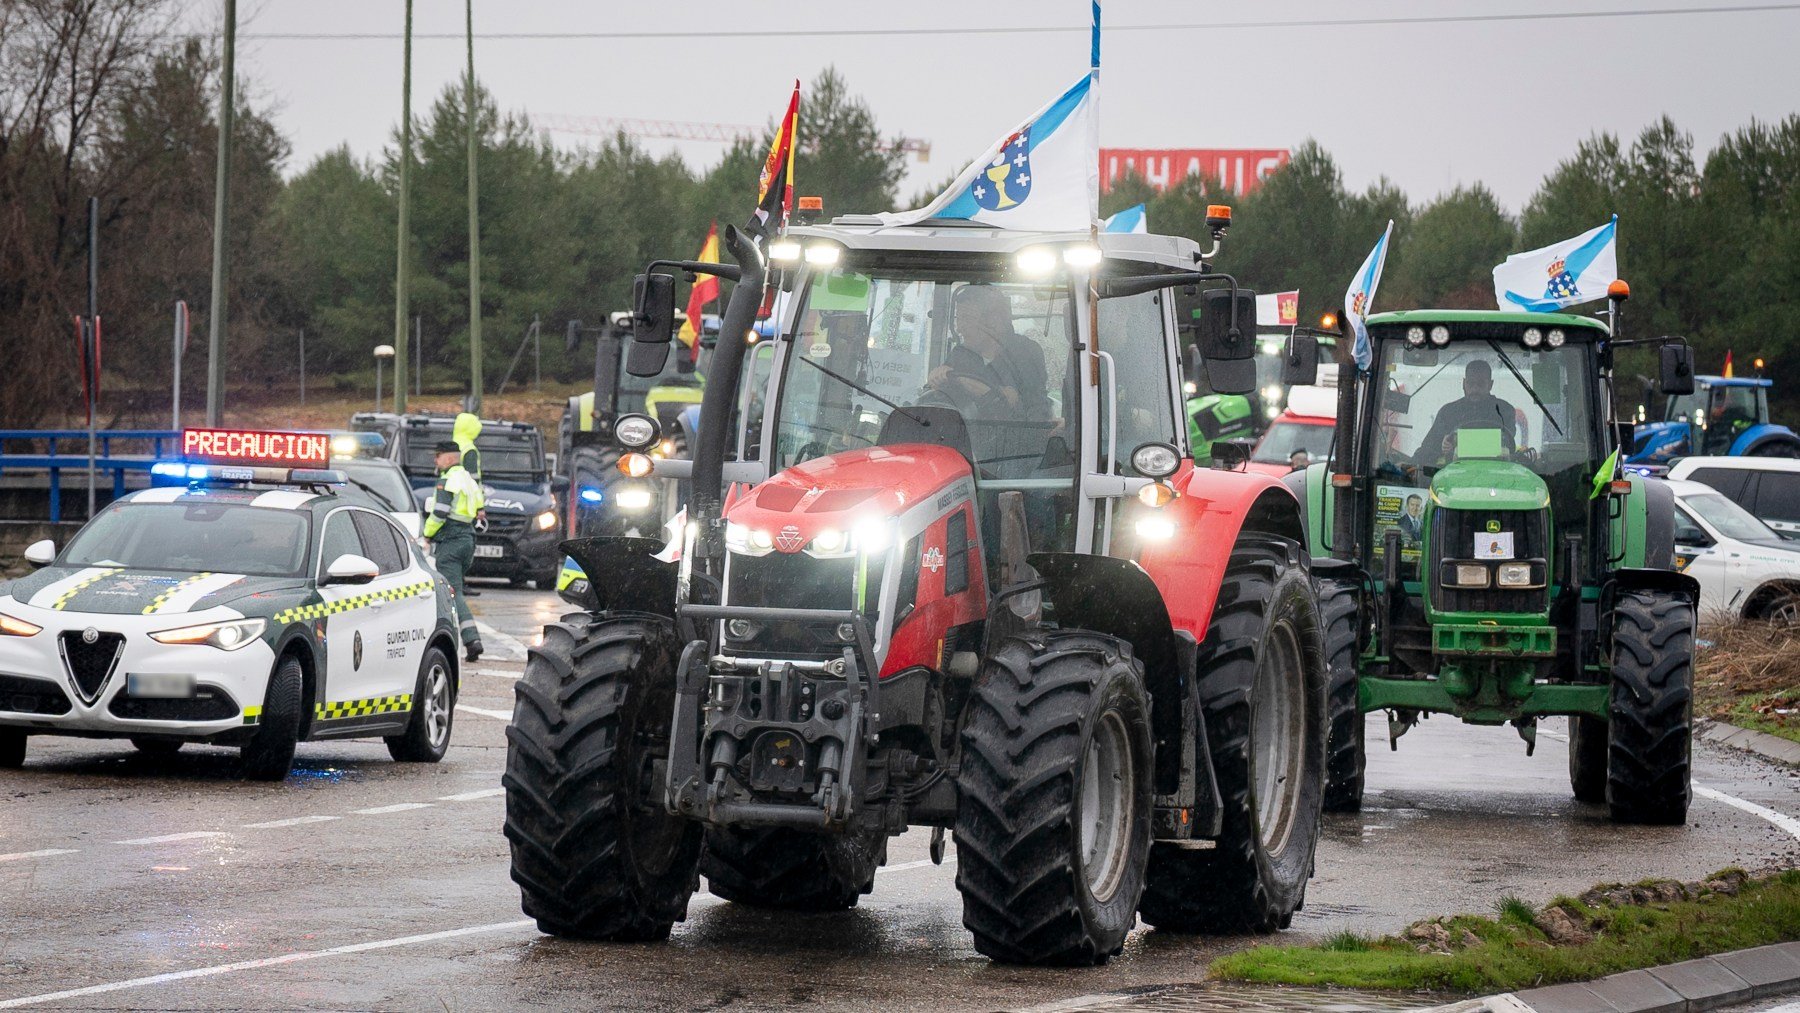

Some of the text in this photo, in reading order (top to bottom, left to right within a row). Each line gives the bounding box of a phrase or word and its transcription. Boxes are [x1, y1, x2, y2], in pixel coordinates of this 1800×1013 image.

[184, 431, 327, 460] PRECAUCION
[387, 628, 426, 645] GUARDIA CIVIL
